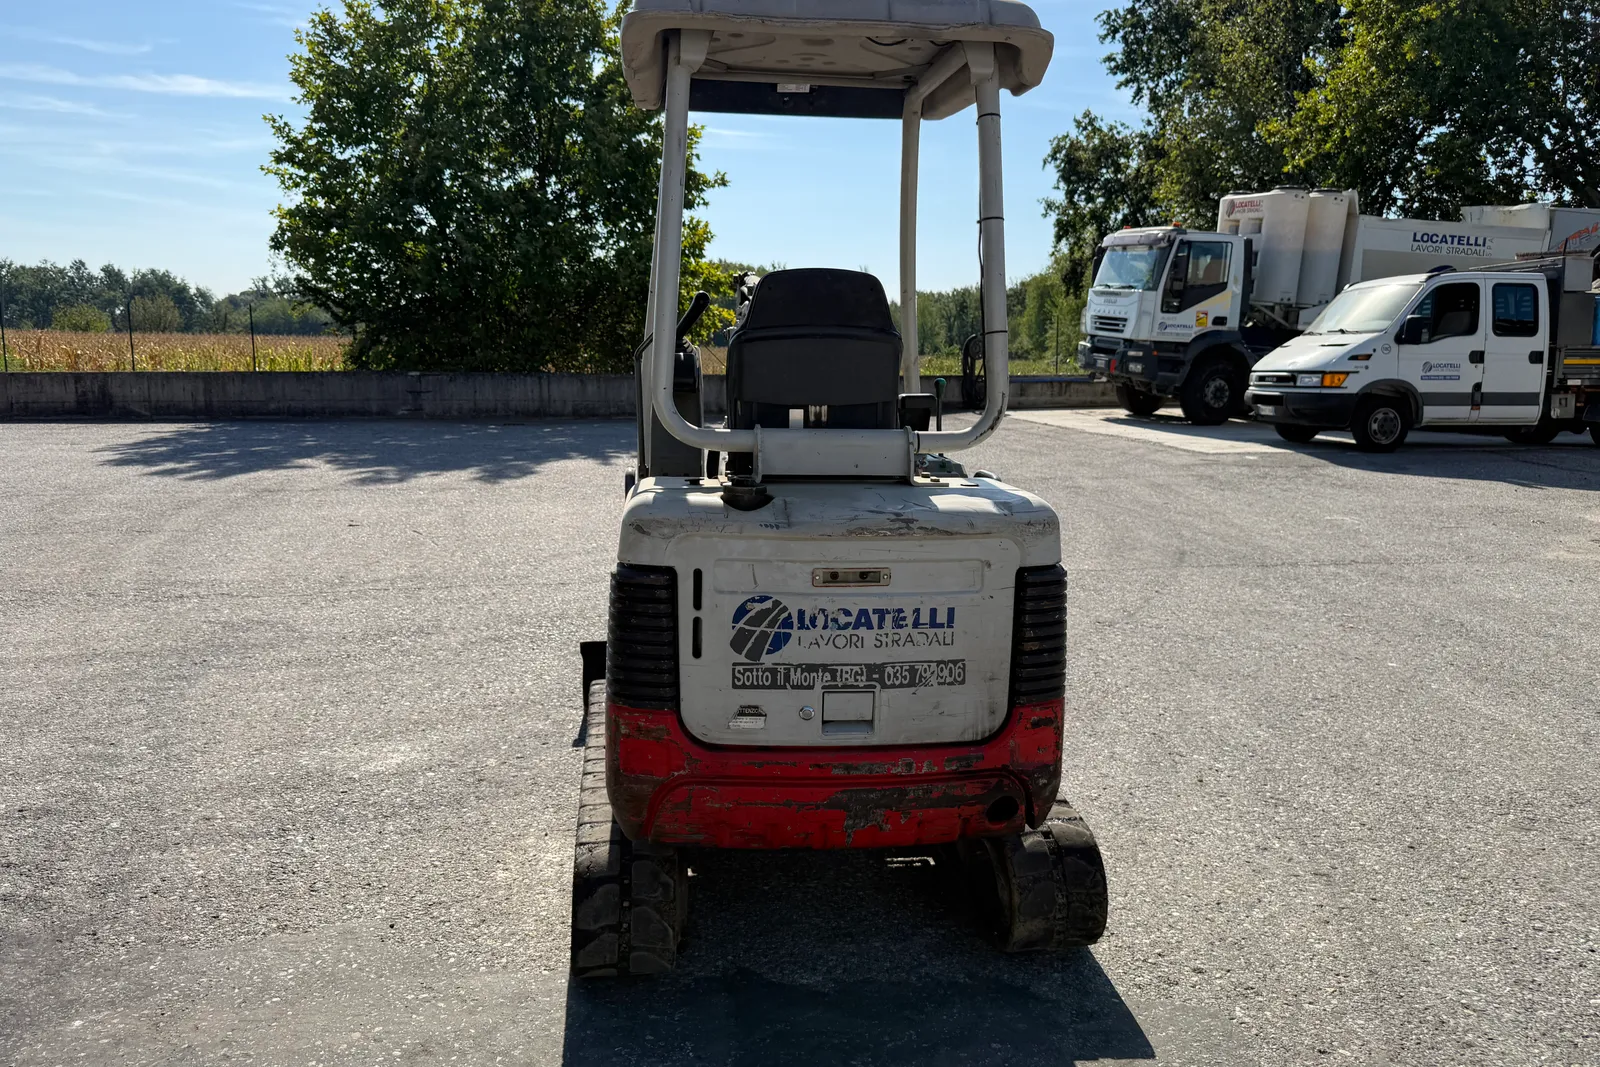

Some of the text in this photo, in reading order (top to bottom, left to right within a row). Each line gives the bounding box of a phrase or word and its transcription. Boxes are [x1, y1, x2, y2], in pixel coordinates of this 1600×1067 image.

[1412, 232, 1487, 247] LOCATELLI
[1410, 243, 1486, 257] LAVORI STRADALI
[796, 606, 956, 631] LOCATELLI
[798, 631, 955, 650] LAVORI STRADALI
[734, 668, 771, 686] Sotto
[777, 667, 785, 686] il
[789, 667, 831, 686] Monte
[884, 665, 910, 686] 035
